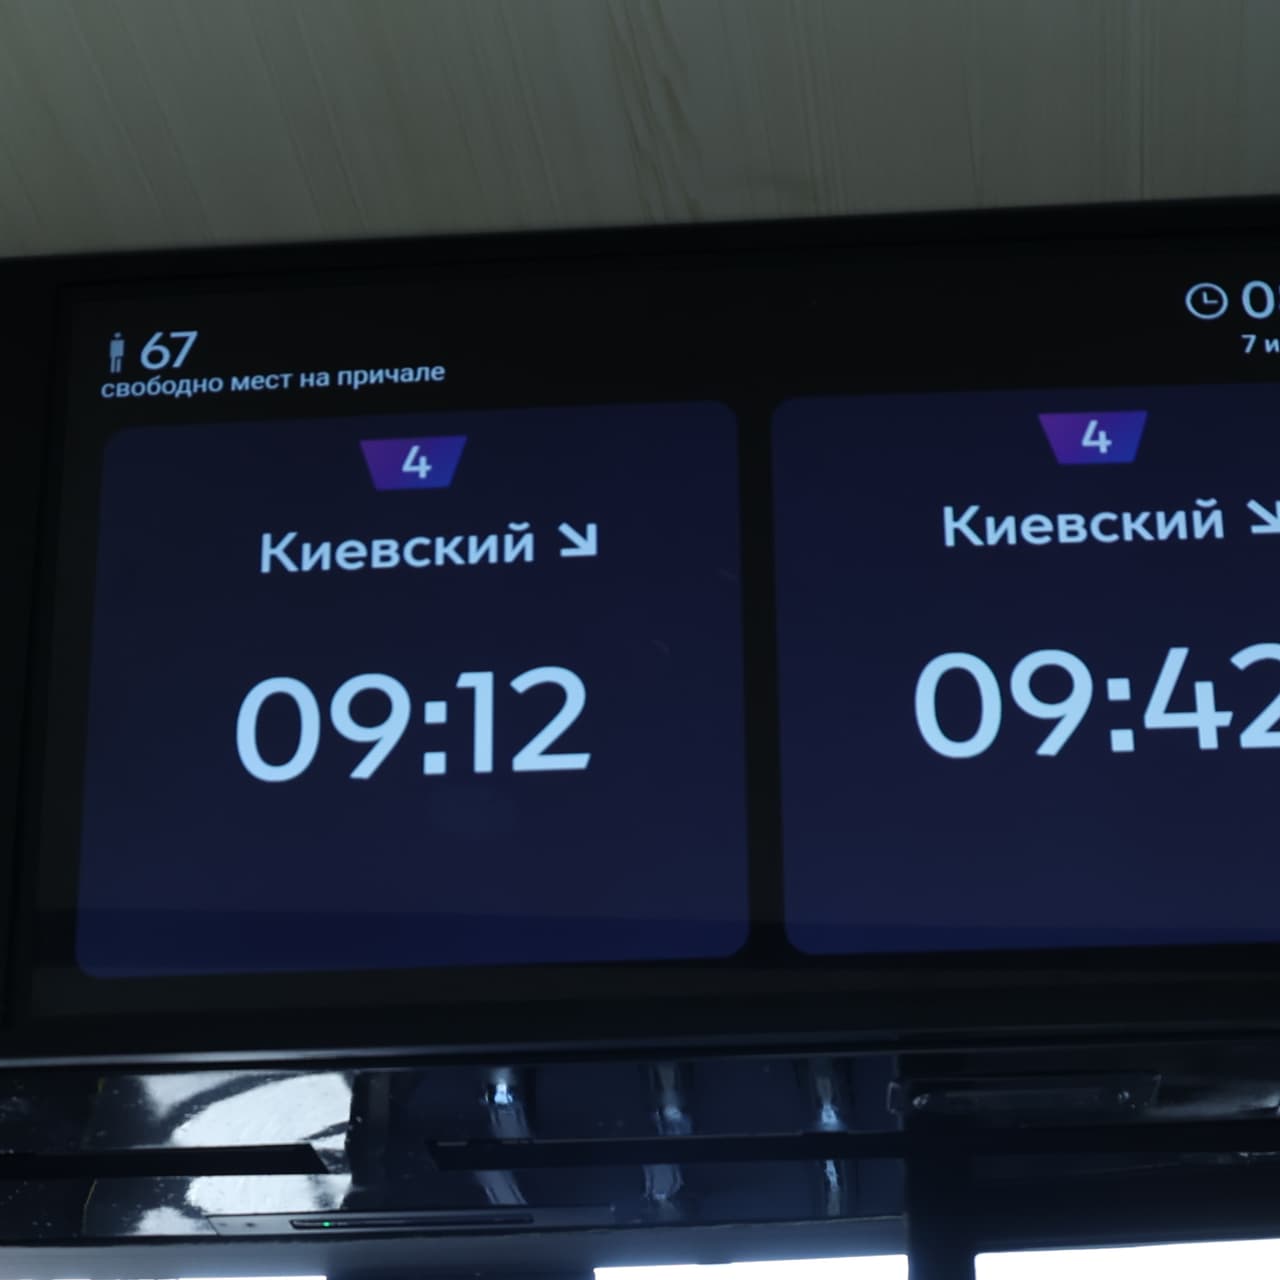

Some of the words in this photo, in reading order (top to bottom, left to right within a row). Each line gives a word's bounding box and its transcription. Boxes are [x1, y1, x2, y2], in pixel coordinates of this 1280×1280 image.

[140, 330, 198, 370] 67
[1241, 333, 1257, 355] 7
[100, 375, 224, 398] свободно
[230, 371, 293, 392] мест
[299, 370, 330, 388] на
[337, 365, 446, 390] причале
[1082, 420, 1112, 454] 4
[402, 445, 432, 479] 4
[942, 497, 1225, 547] Киевский
[260, 522, 535, 574] Киевский
[235, 665, 591, 782] 09:12
